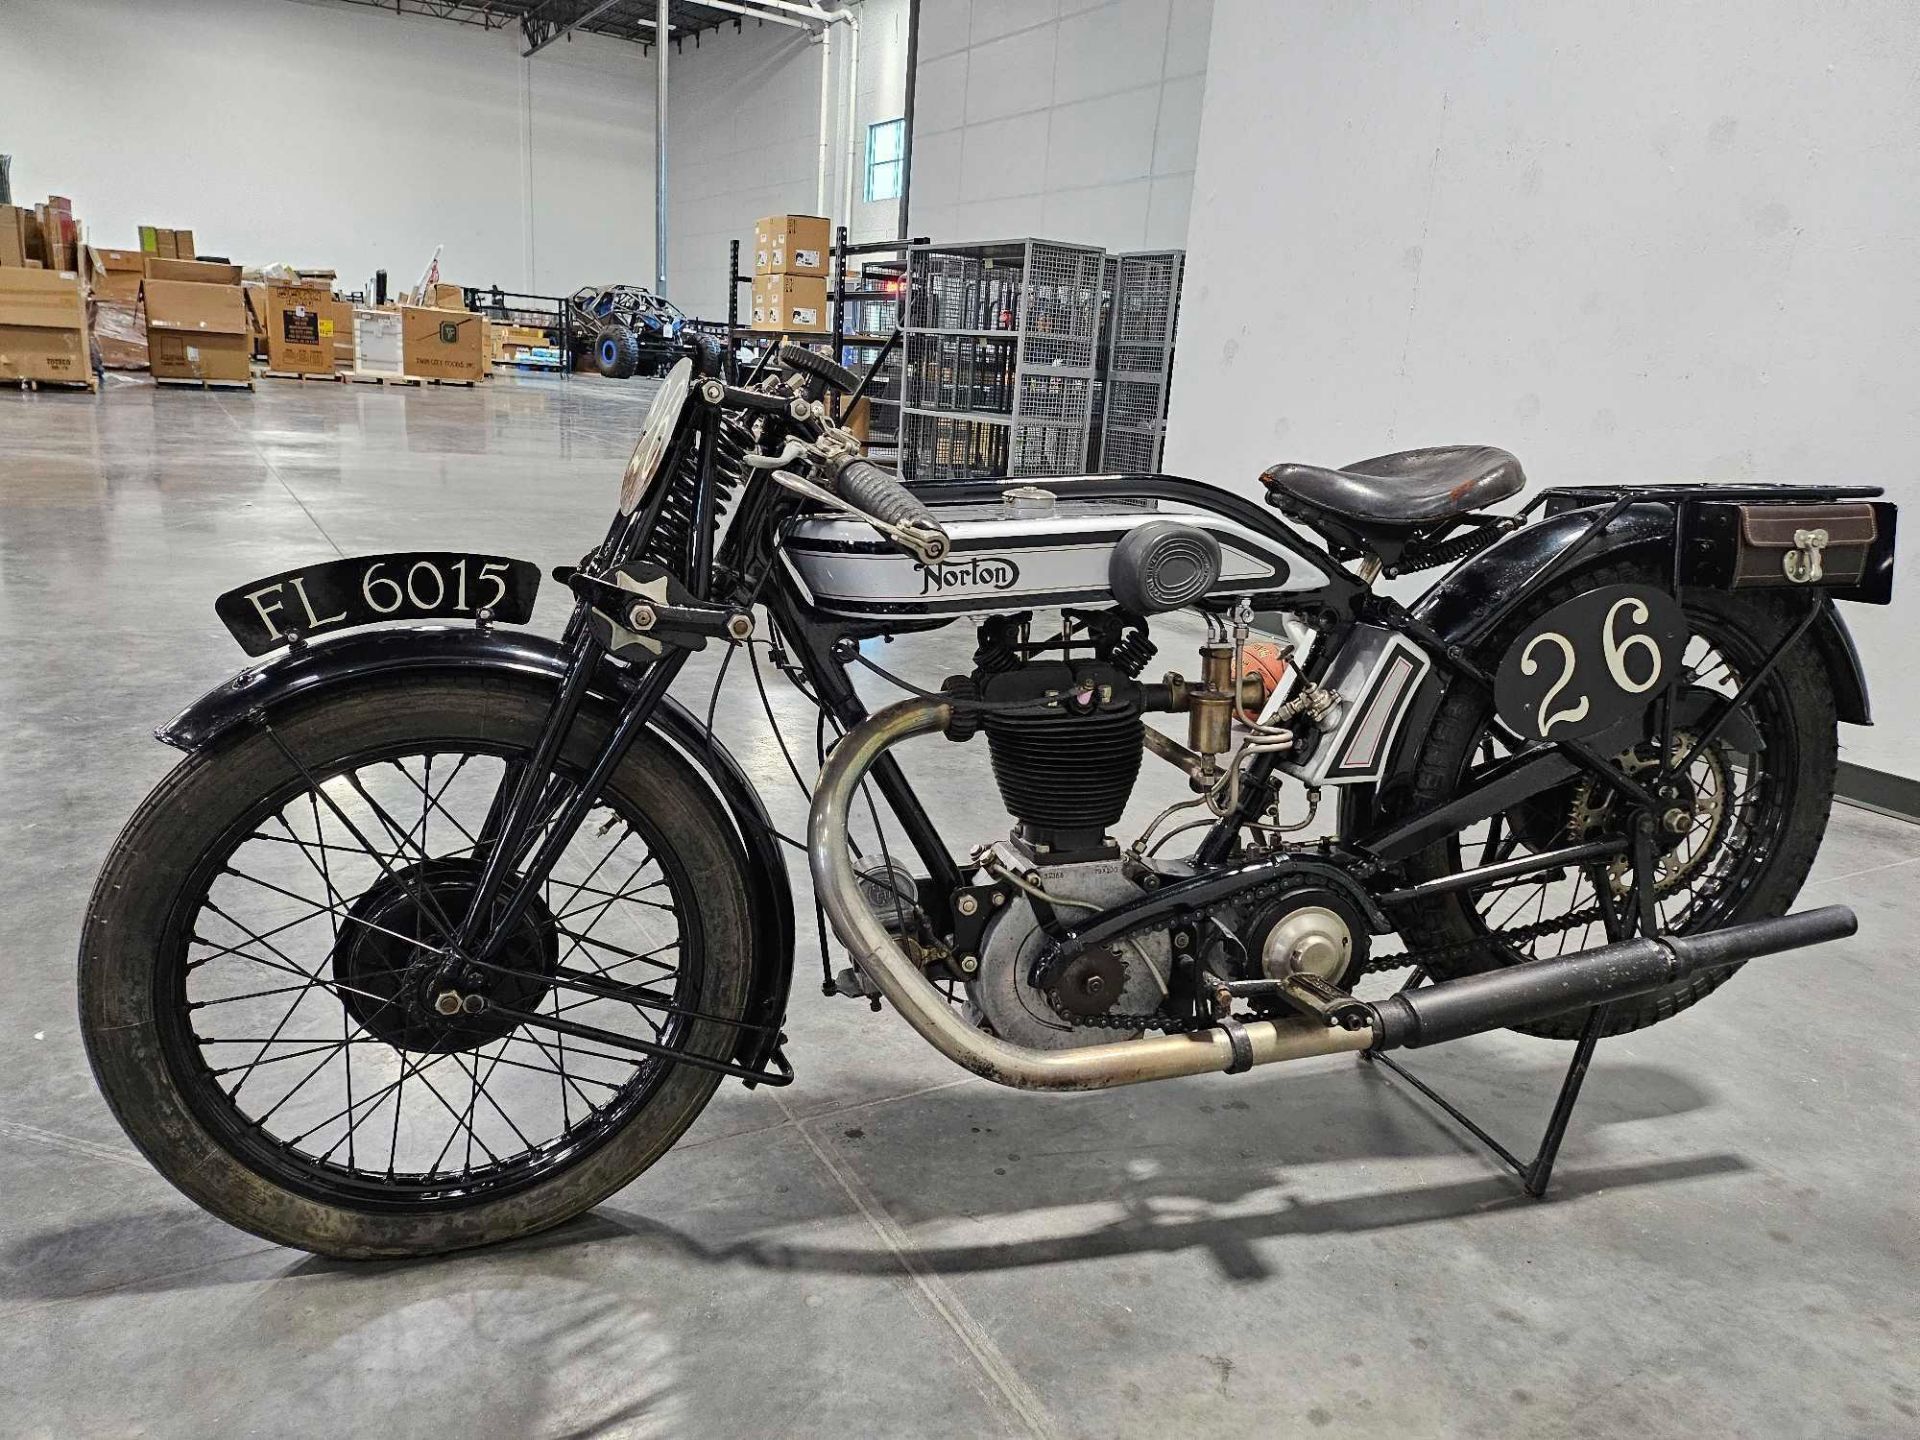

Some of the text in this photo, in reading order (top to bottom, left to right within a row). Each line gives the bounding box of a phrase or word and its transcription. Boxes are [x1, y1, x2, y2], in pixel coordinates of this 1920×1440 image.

[244, 559, 511, 642] FL 6015
[913, 557, 1020, 595] Norton
[1520, 597, 1662, 737] 26
